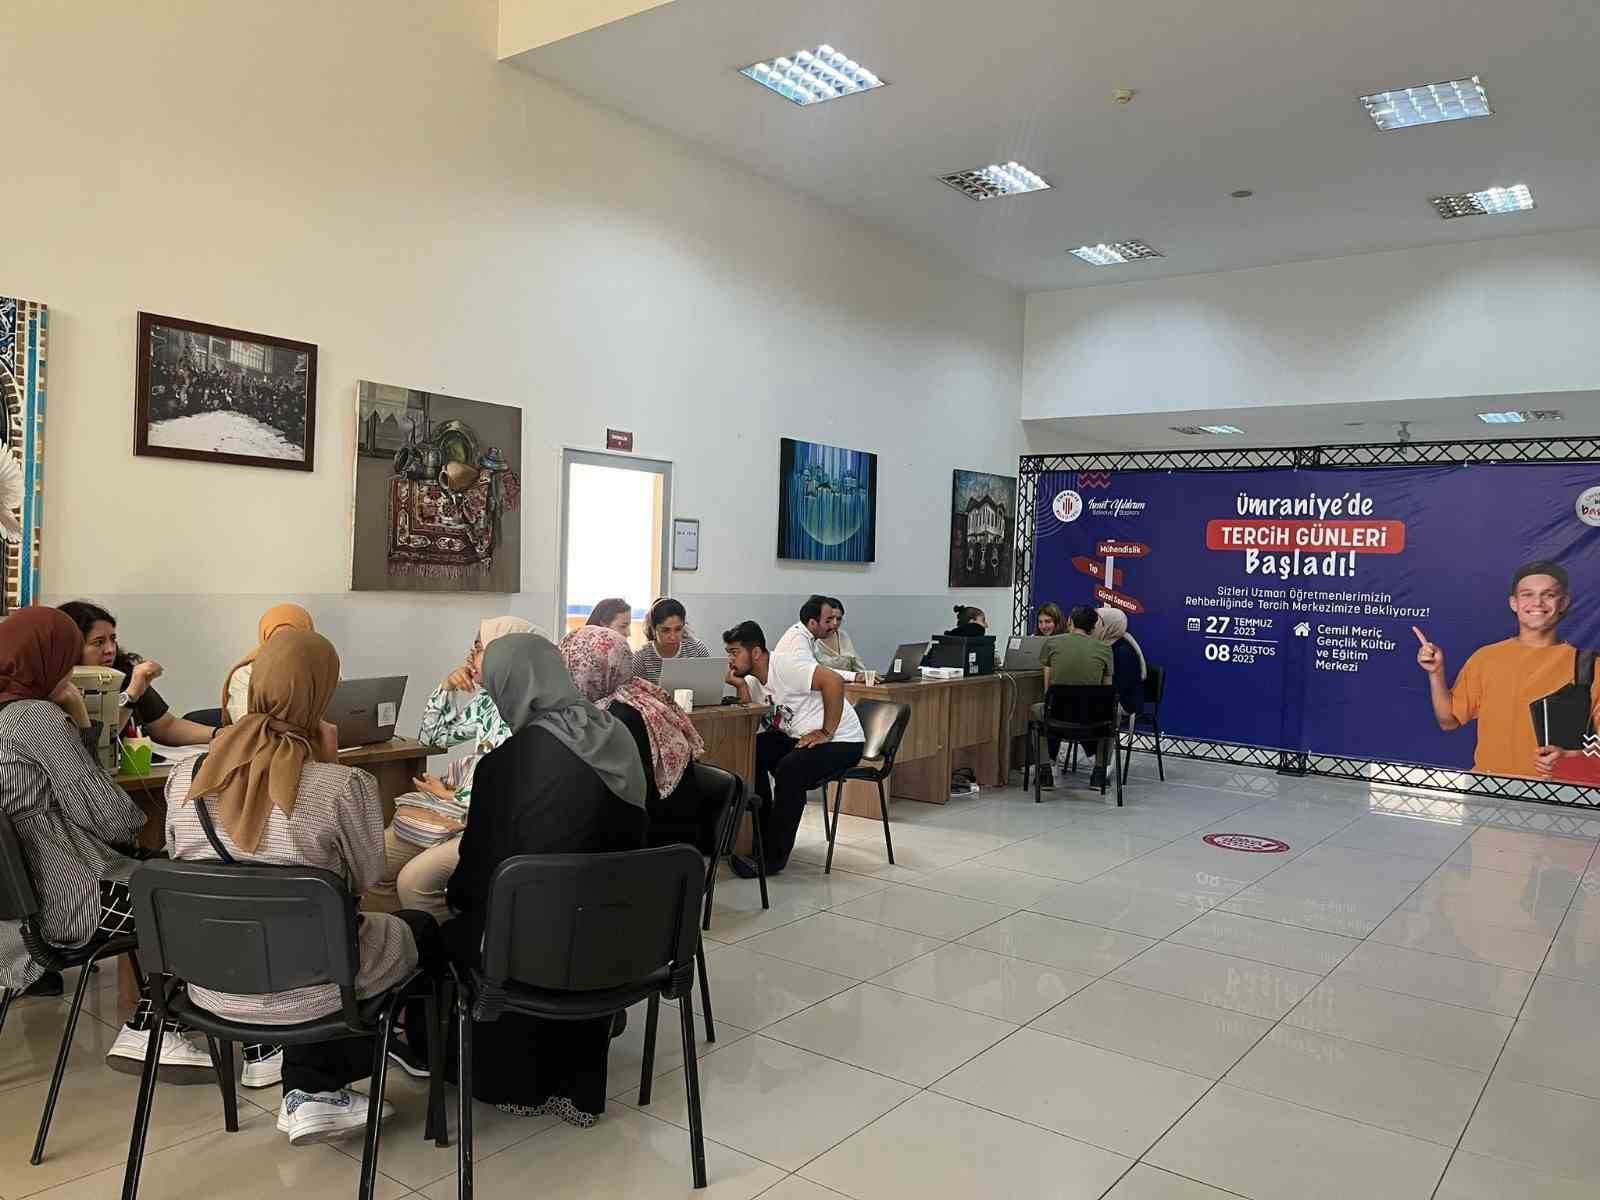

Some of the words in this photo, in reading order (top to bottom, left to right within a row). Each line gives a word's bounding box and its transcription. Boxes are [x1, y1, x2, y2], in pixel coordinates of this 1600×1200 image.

[1100, 544, 1141, 554] Mühendislik
[1245, 548, 1356, 580] Başladı!
[1217, 586, 1249, 597] Sizleri
[1251, 587, 1286, 599] Uzman
[1289, 588, 1391, 603] Öğretmenlerimizin
[1185, 596, 1254, 610] Rehberliğinde
[1258, 599, 1289, 611] Tercih
[1292, 601, 1361, 614] Merkezimize
[1364, 604, 1430, 618] Bekliyoruz!
[1205, 616, 1231, 634] 27
[1234, 617, 1273, 628] TEMMUZ
[1233, 627, 1256, 636] 2023
[1317, 624, 1349, 635] Cemil
[1351, 626, 1383, 638] Meriç
[1316, 636, 1358, 649] Gençlik
[1360, 639, 1397, 651] Kültür
[1204, 643, 1231, 662] 08
[1232, 644, 1276, 656] AĞUSTOS
[1232, 654, 1255, 664] 2023
[1316, 649, 1329, 658] ve
[1332, 649, 1369, 661] Eğitim
[1315, 660, 1359, 672] Merkezi
